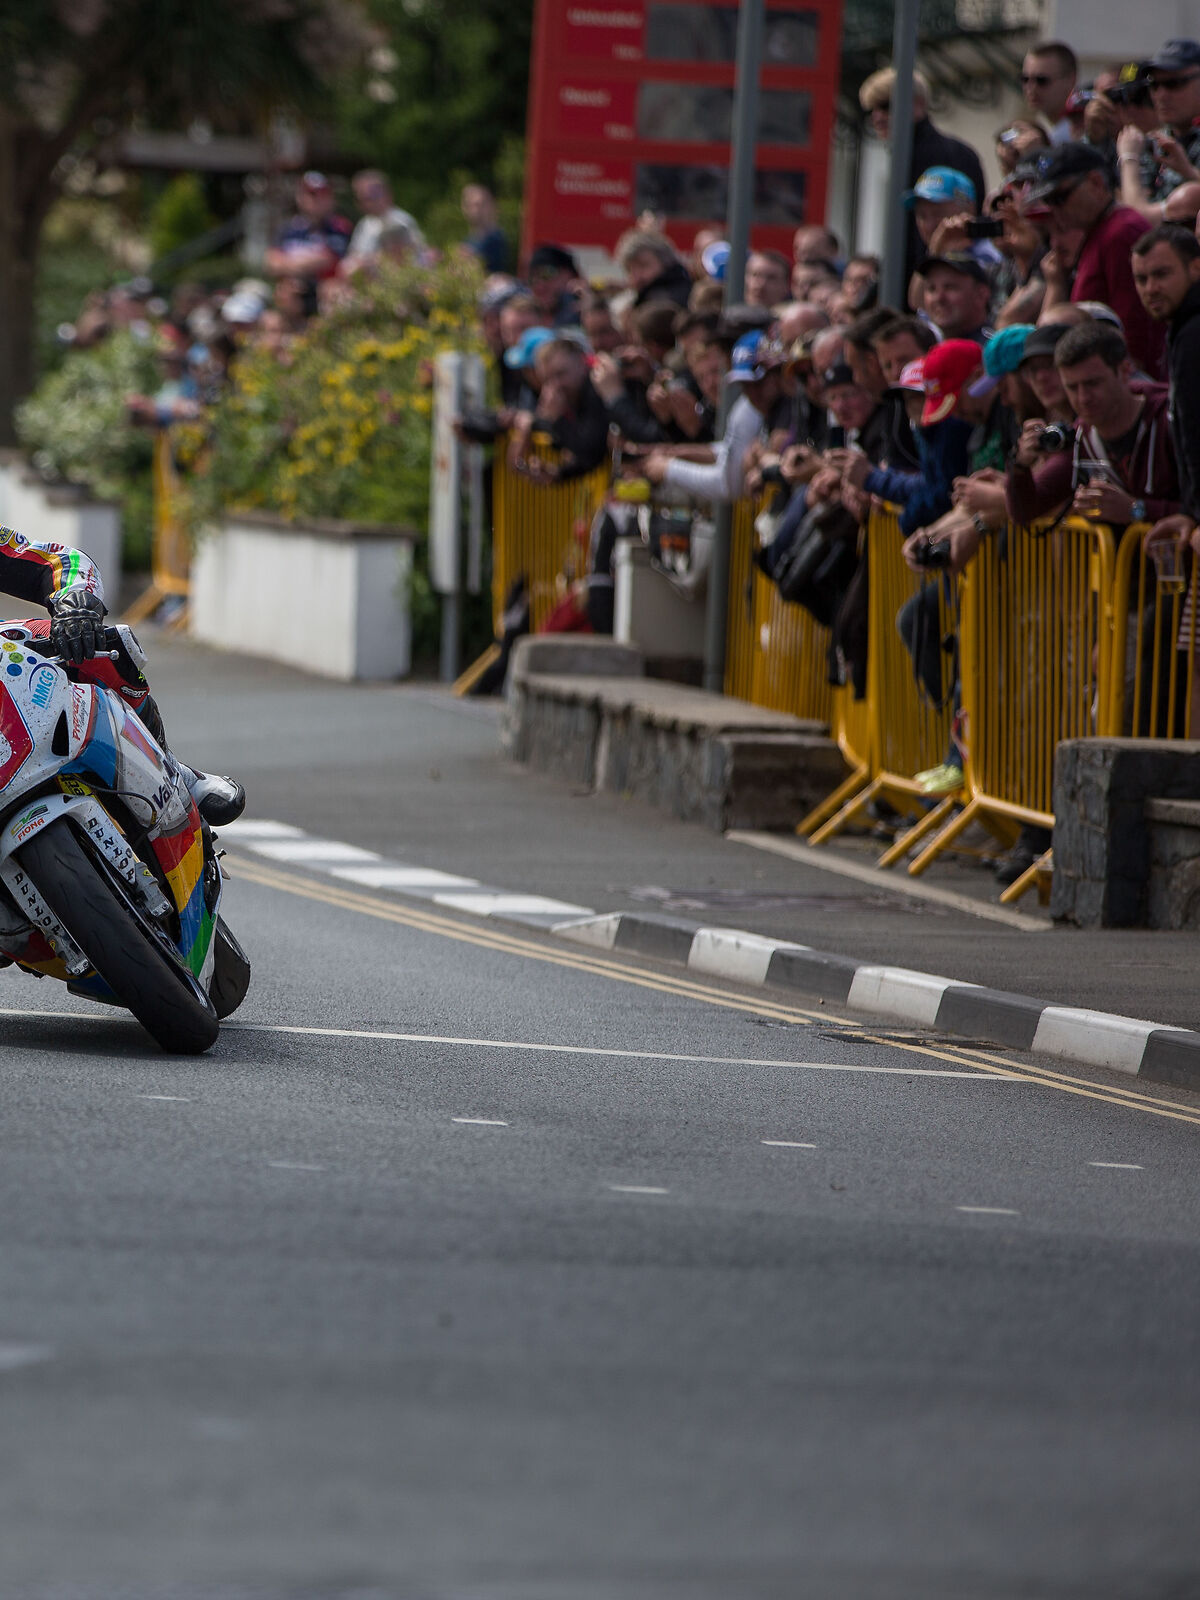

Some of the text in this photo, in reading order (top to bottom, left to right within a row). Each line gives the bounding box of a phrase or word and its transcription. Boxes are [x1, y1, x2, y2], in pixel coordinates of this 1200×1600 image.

[31, 669, 55, 709] MMCG
[17, 817, 46, 842] FIONA
[88, 817, 136, 883] DUNLOP
[14, 872, 62, 936] DUNLOP
